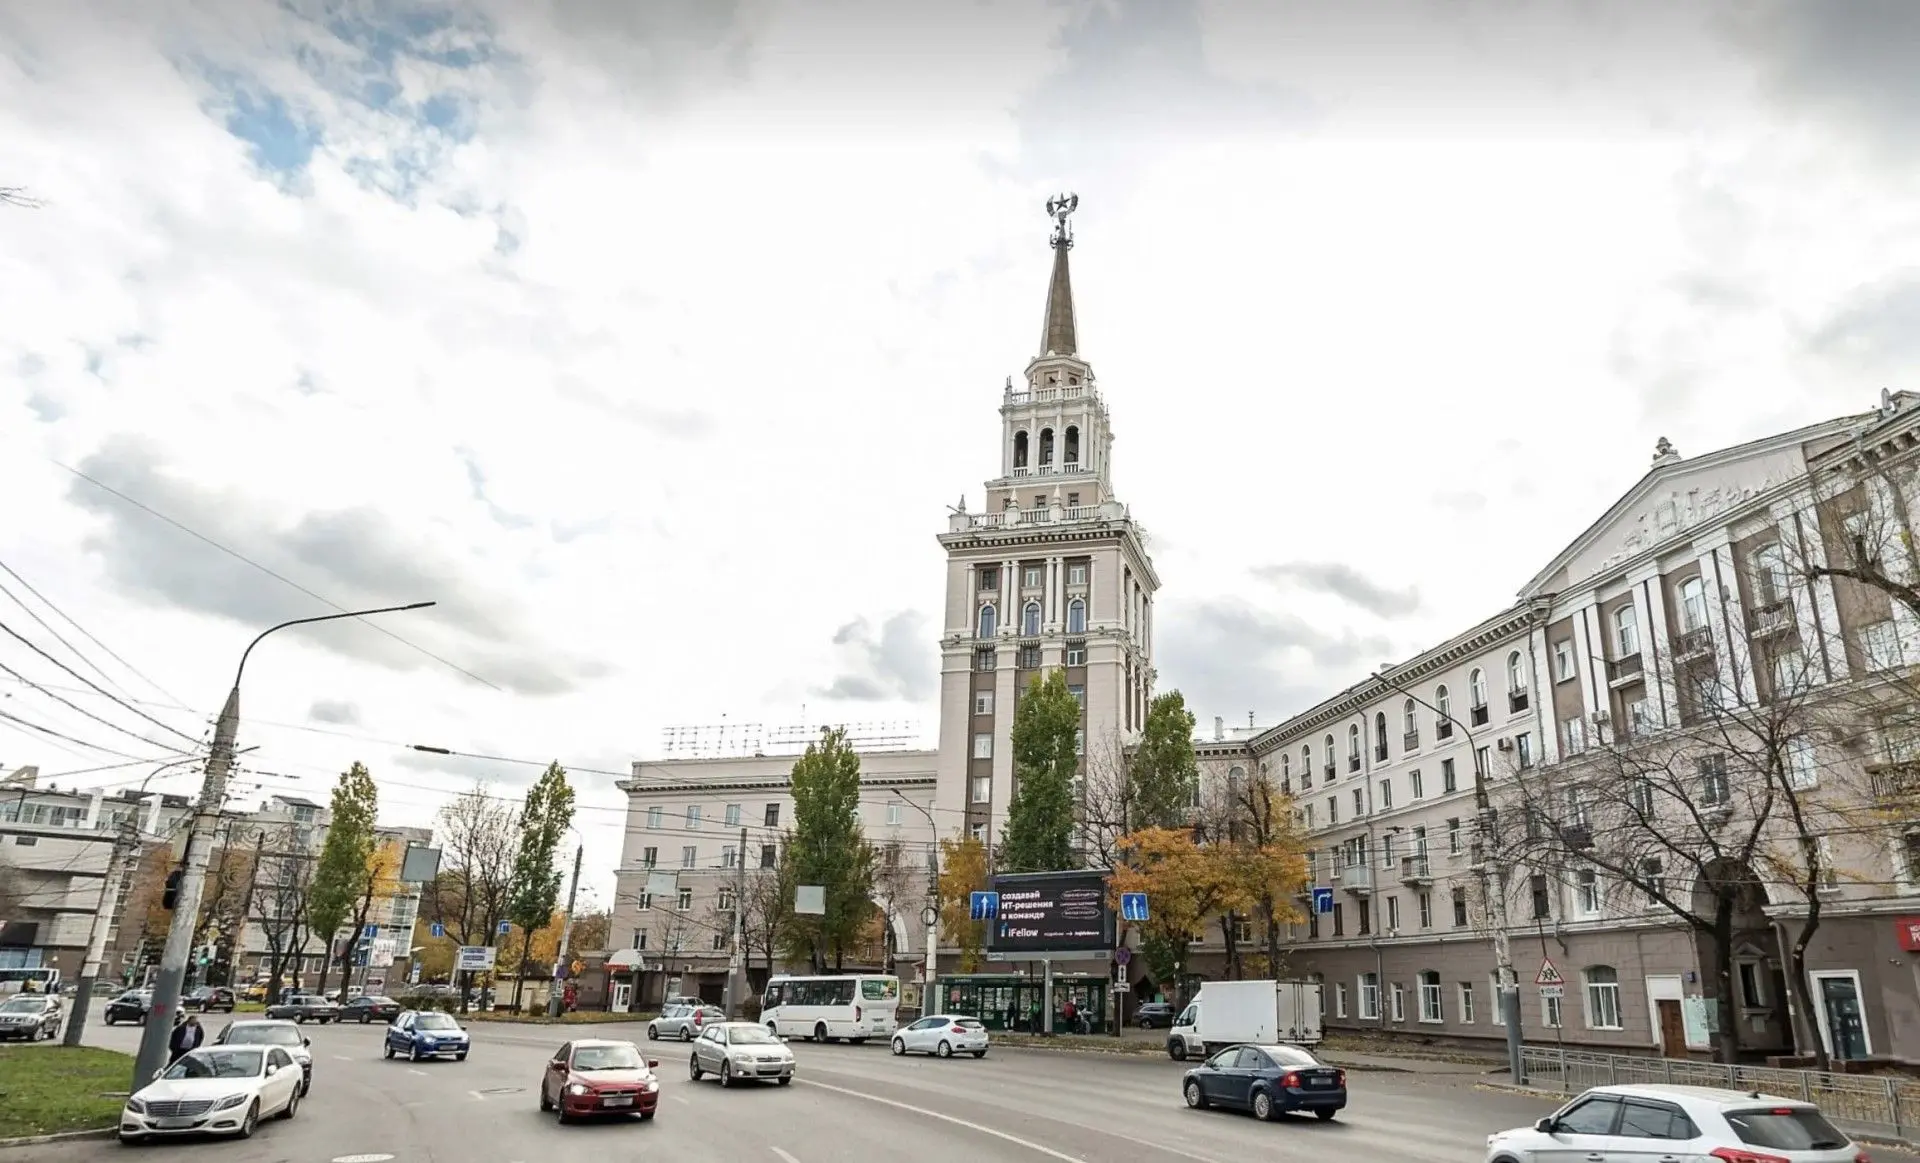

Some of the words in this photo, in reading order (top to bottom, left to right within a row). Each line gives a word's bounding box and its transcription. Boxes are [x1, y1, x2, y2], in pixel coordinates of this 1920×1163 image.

[1002, 891, 1040, 900] создавай
[1001, 901, 1053, 911] ИТ-решения
[1008, 911, 1045, 920] команде
[1008, 928, 1038, 938] iFellow
